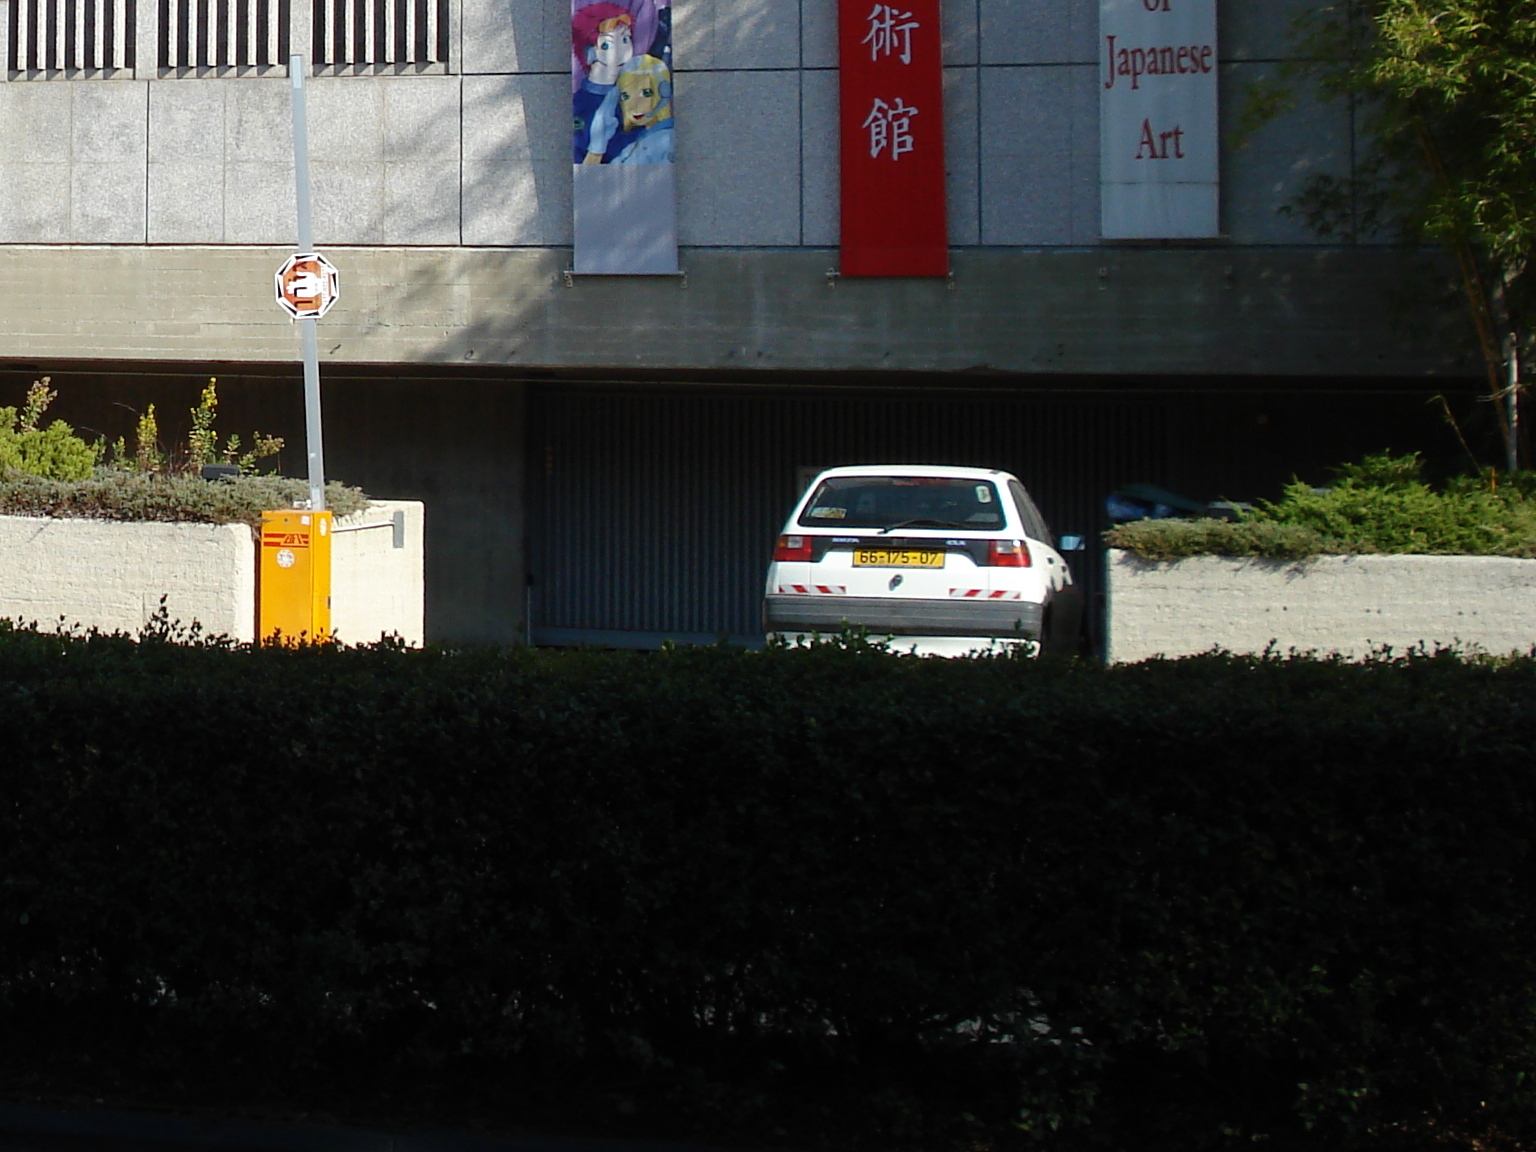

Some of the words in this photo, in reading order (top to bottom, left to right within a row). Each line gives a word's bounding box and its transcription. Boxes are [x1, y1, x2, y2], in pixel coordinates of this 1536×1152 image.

[1105, 34, 1212, 90] Japanese
[1135, 118, 1185, 160] Art
[859, 550, 939, 565] 66-175-07
